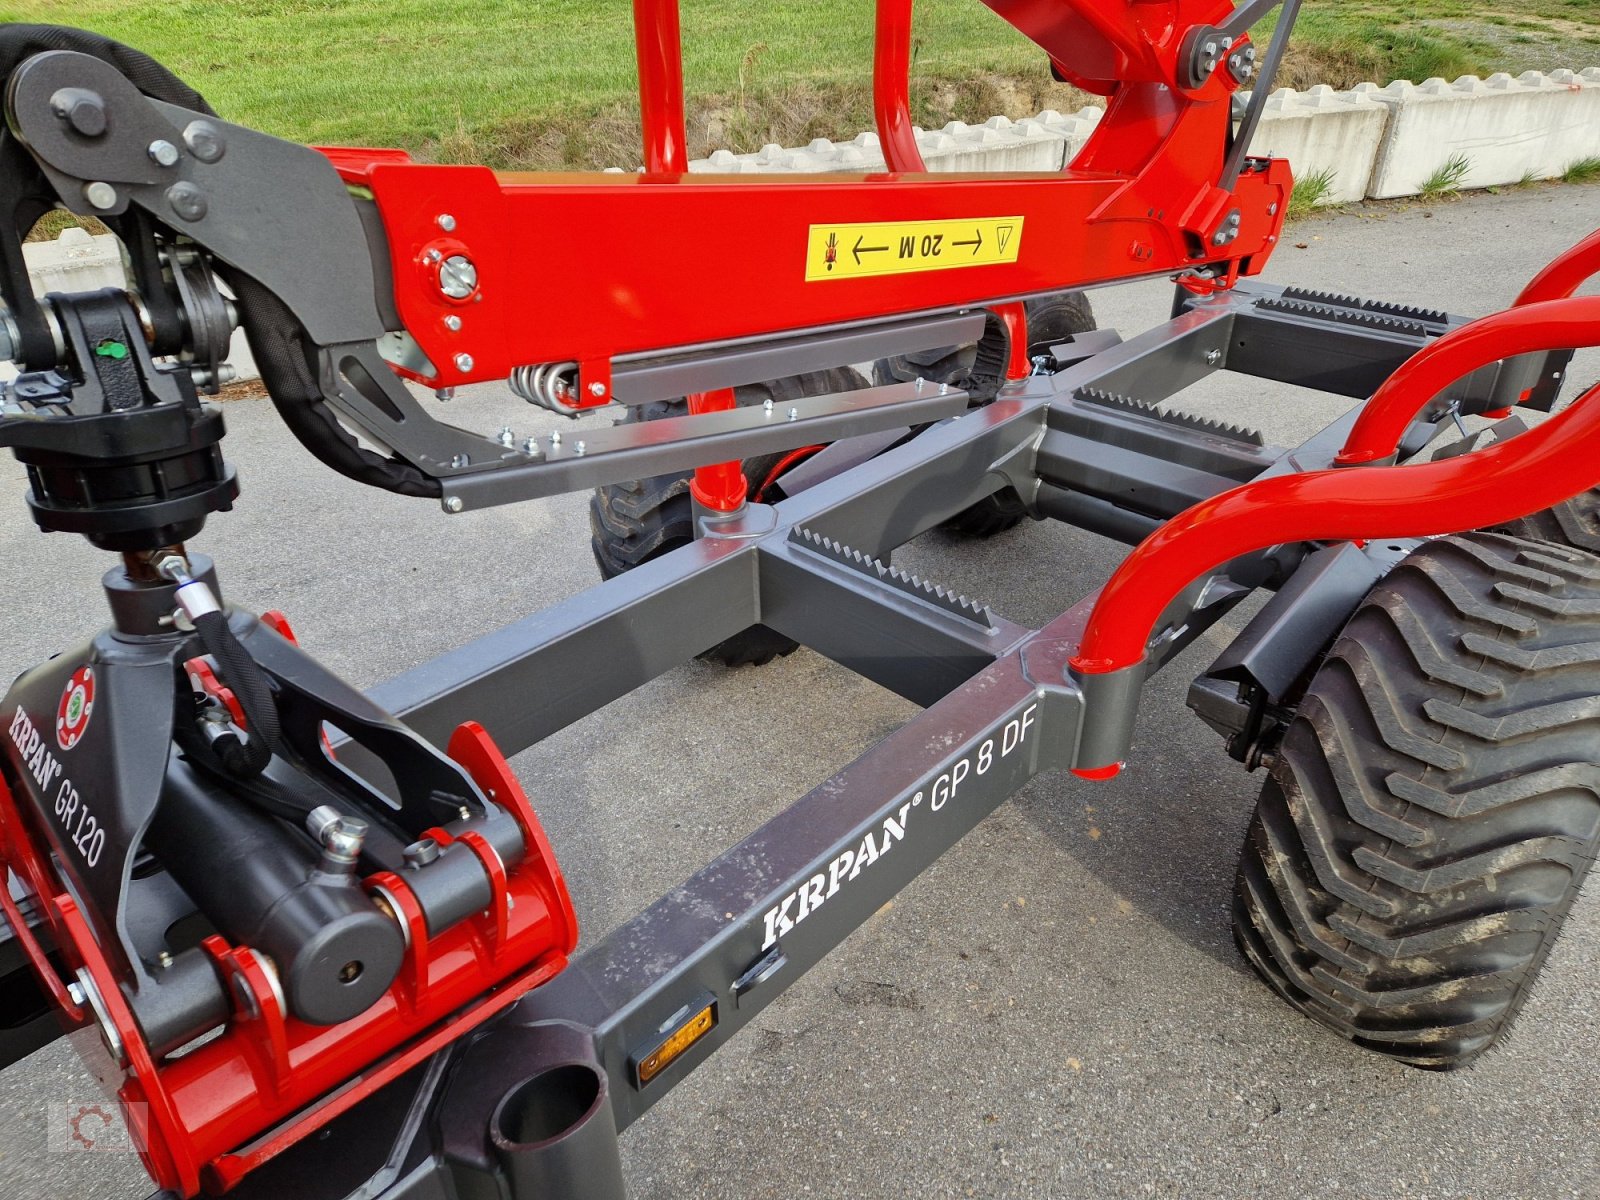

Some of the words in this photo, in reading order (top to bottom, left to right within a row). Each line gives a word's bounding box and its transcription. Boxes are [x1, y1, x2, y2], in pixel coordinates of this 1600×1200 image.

[899, 236, 916, 259] M
[921, 234, 944, 257] 20
[931, 758, 970, 812] GP
[976, 739, 994, 775] 8
[1001, 703, 1037, 758] DF
[54, 778, 79, 831] GR
[71, 804, 105, 868] 120
